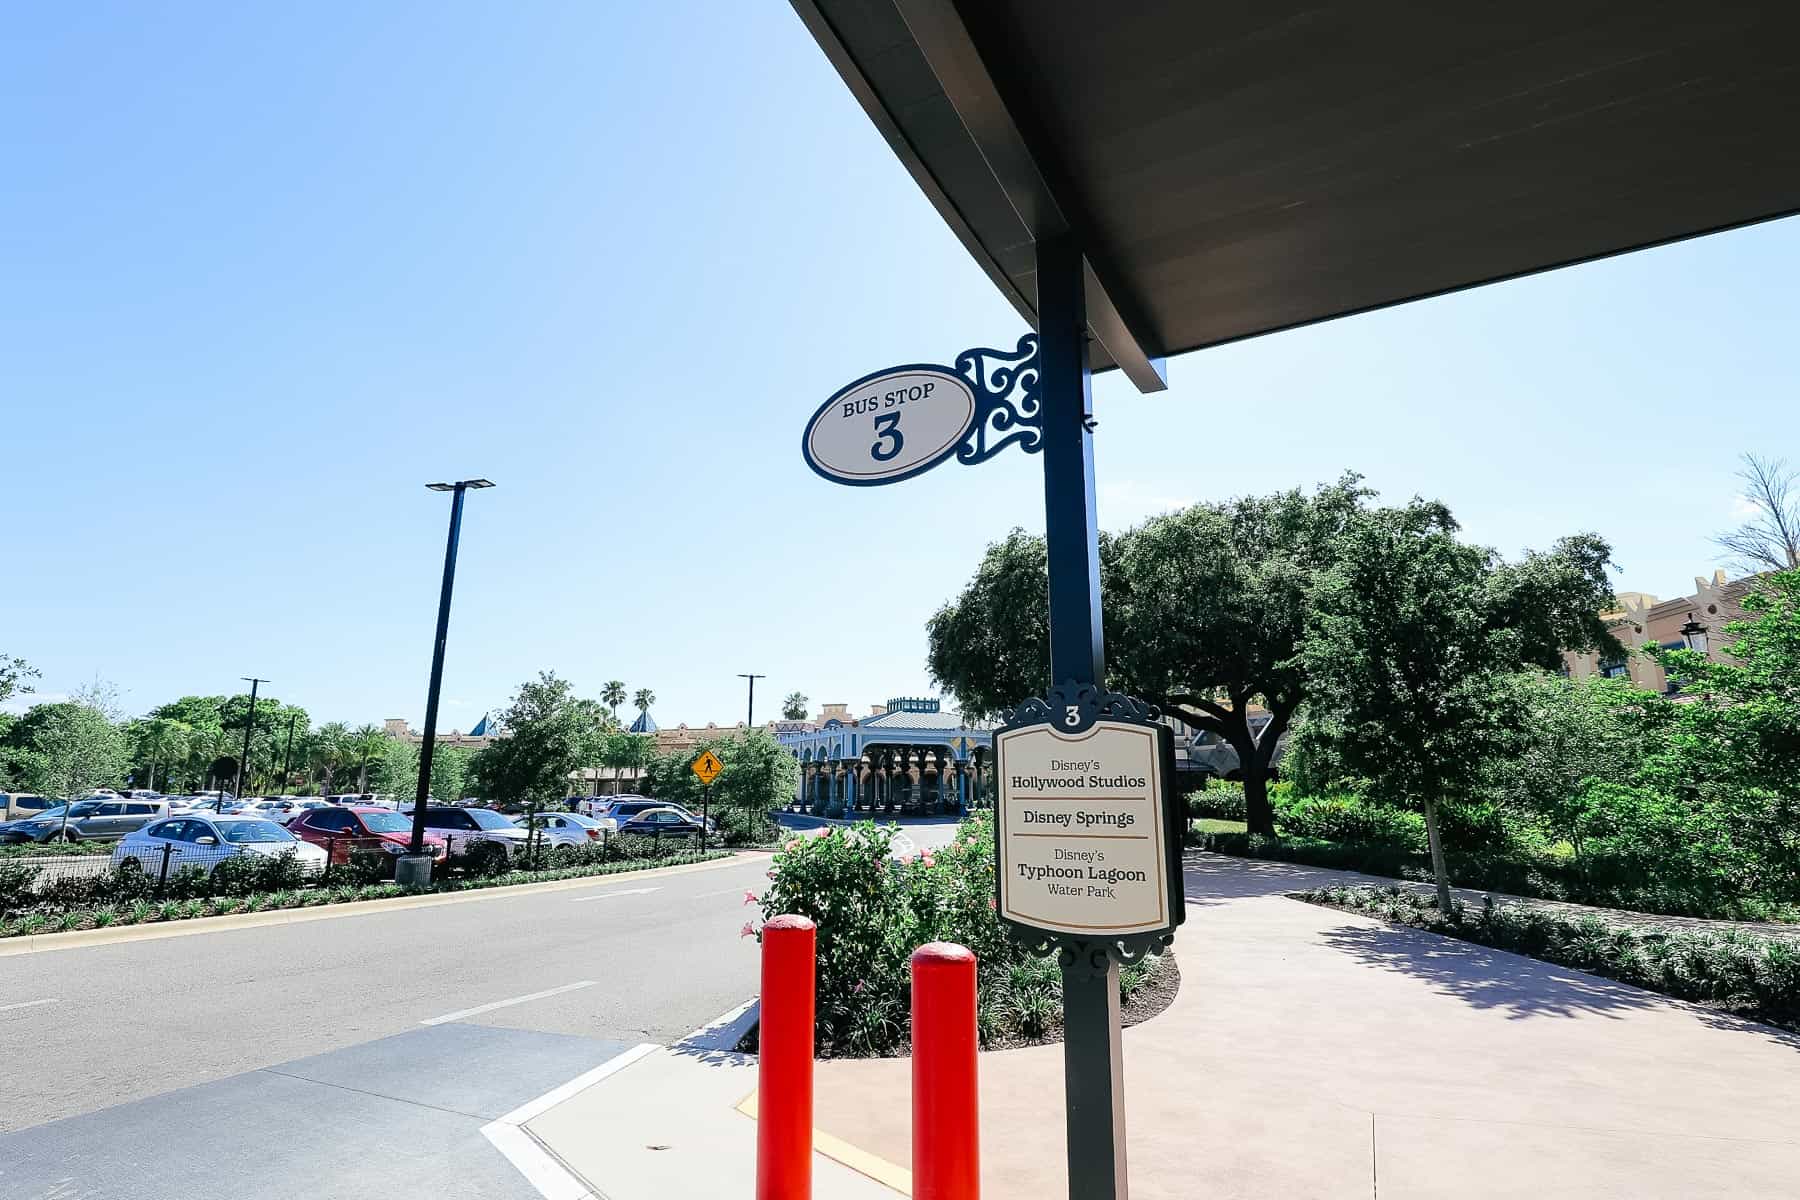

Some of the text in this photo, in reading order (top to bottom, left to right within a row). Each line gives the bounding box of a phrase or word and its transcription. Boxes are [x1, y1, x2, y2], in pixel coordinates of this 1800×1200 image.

[842, 383, 935, 417] BUS STOP
[871, 411, 904, 461] 3
[1065, 705, 1081, 725] 3
[1051, 759, 1100, 772] Disney's
[1012, 776, 1146, 791] Hollywood Studios
[1023, 810, 1135, 828] Disney Springs
[1055, 849, 1104, 863] Disney's
[1017, 864, 1146, 884] Typhoon Lagoon
[1047, 884, 1116, 899] Water Park
